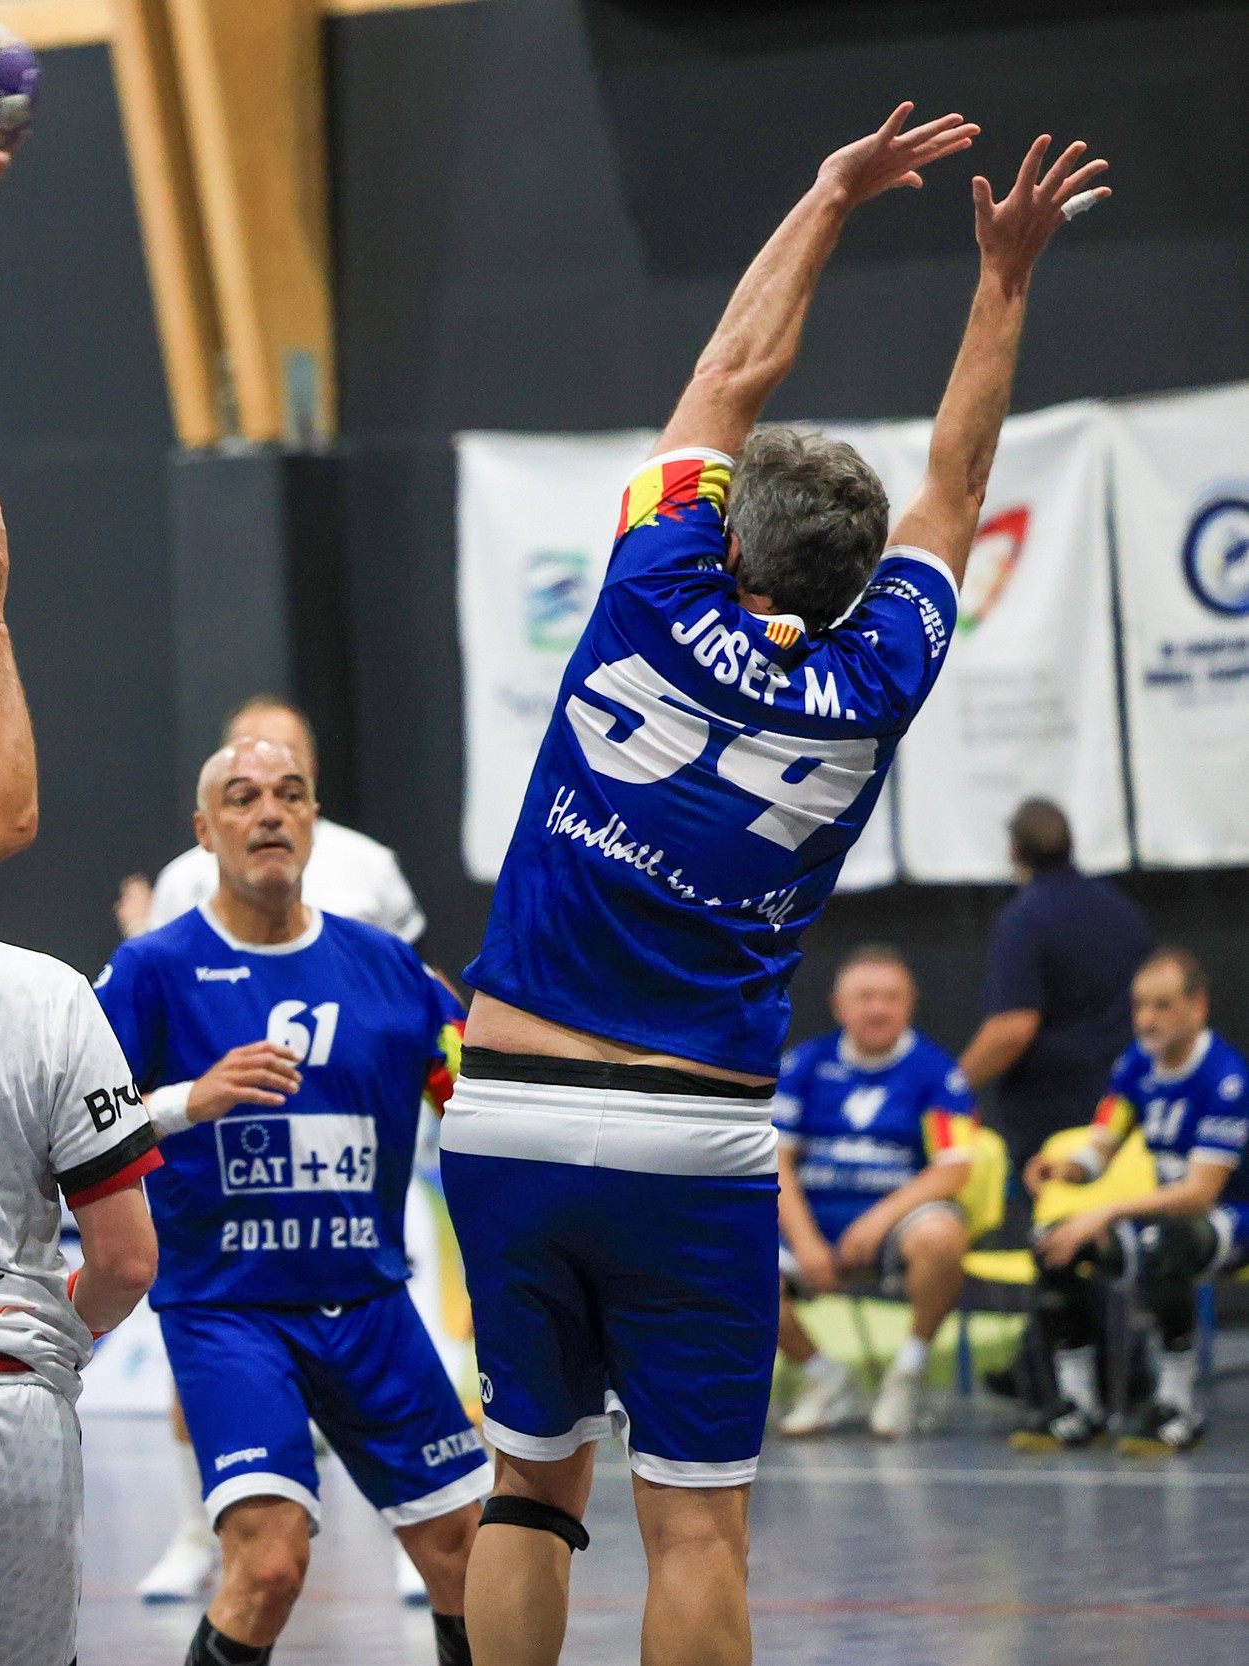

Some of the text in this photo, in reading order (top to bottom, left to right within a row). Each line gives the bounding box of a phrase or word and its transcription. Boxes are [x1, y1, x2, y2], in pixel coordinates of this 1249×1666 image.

[671, 608, 856, 720] JOSEP M.
[546, 786, 665, 876] Handball
[266, 1000, 340, 1067] 61
[228, 1156, 287, 1187] CAT
[221, 1219, 300, 1252] 2010
